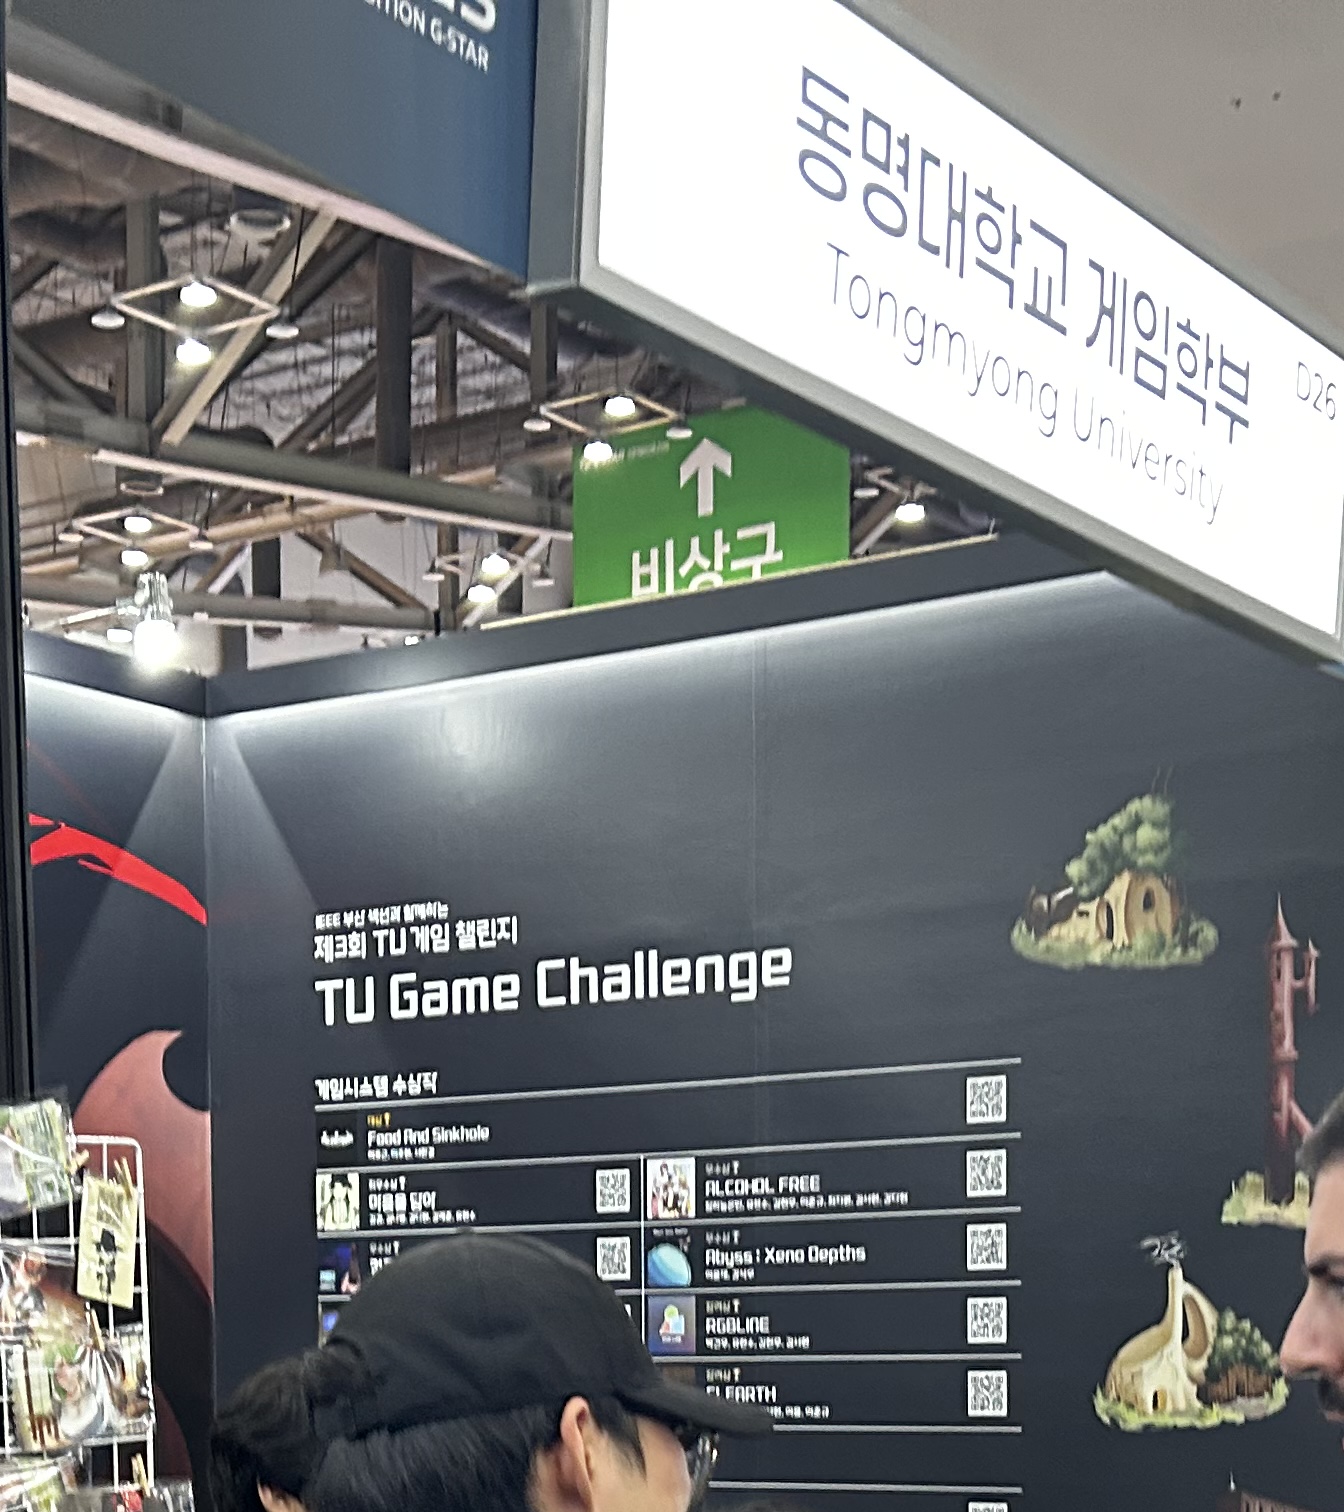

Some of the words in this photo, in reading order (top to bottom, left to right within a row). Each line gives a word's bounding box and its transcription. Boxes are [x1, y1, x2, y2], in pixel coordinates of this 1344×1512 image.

[796, 65, 1068, 336] 동명대학교
[1086, 258, 1250, 444] 게임학부
[826, 241, 1059, 438] Tongmyong
[1072, 387, 1223, 525] University
[1296, 361, 1337, 421] D26
[631, 520, 784, 599] 비상구
[313, 930, 367, 964] 제3회
[372, 928, 407, 957] TU
[410, 922, 450, 955] 게임
[455, 915, 518, 952] 챌린지
[314, 974, 374, 1027] TU
[389, 971, 520, 1021] Game
[536, 946, 793, 1009] Challenge
[314, 1074, 389, 1101] 게임시스템
[367, 1128, 401, 1148] Food
[403, 1126, 430, 1146] And
[705, 1177, 775, 1198] ALCOHOL
[778, 1174, 821, 1193] FREE
[705, 1248, 753, 1268] Abyss
[808, 1243, 867, 1267] Depths
